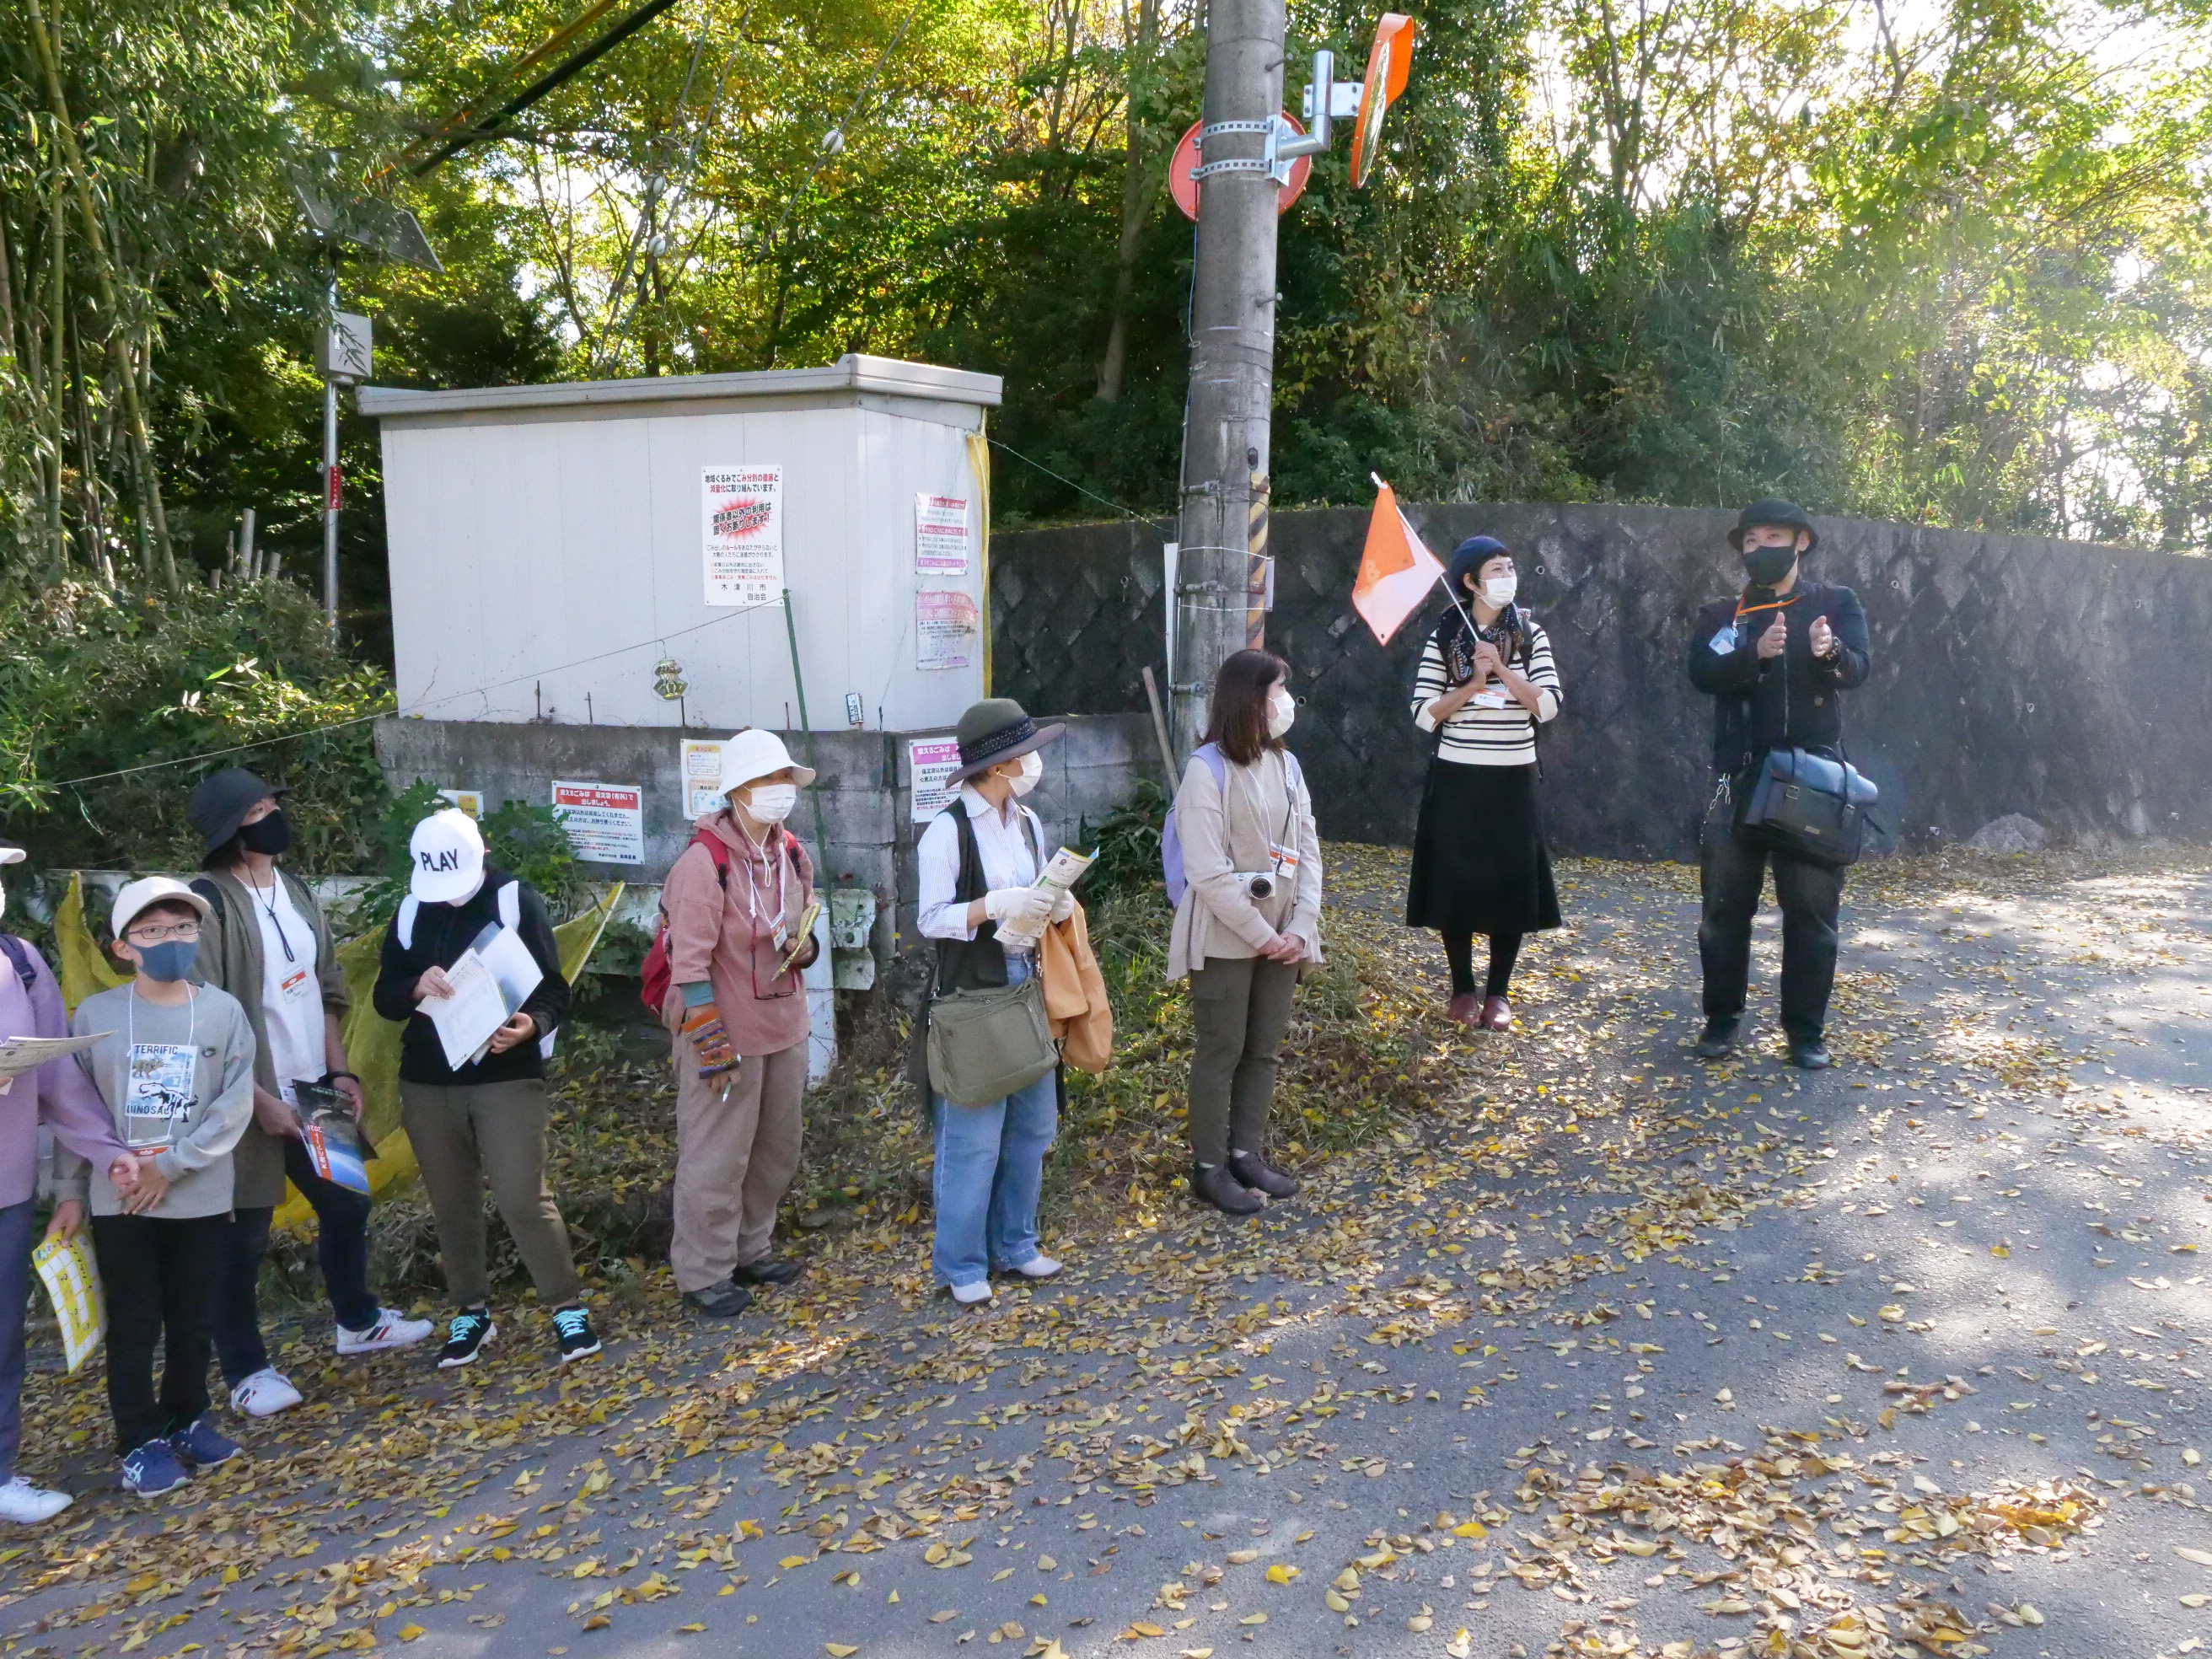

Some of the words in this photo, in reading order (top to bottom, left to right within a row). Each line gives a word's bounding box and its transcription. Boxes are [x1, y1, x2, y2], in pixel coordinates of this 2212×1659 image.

[705, 474, 778, 483] 地域ぐるみでごみ分別の徹底と
[710, 484, 776, 493] 減量化に取り組んでいます。
[713, 502, 771, 523] 関係者以外の利用は
[918, 746, 950, 754] 燃えるごみは
[581, 798, 610, 807] 出しましょう。
[420, 848, 459, 872] PLAY
[135, 1045, 178, 1055] TERRIFIC
[307, 1125, 322, 1133] 2021
